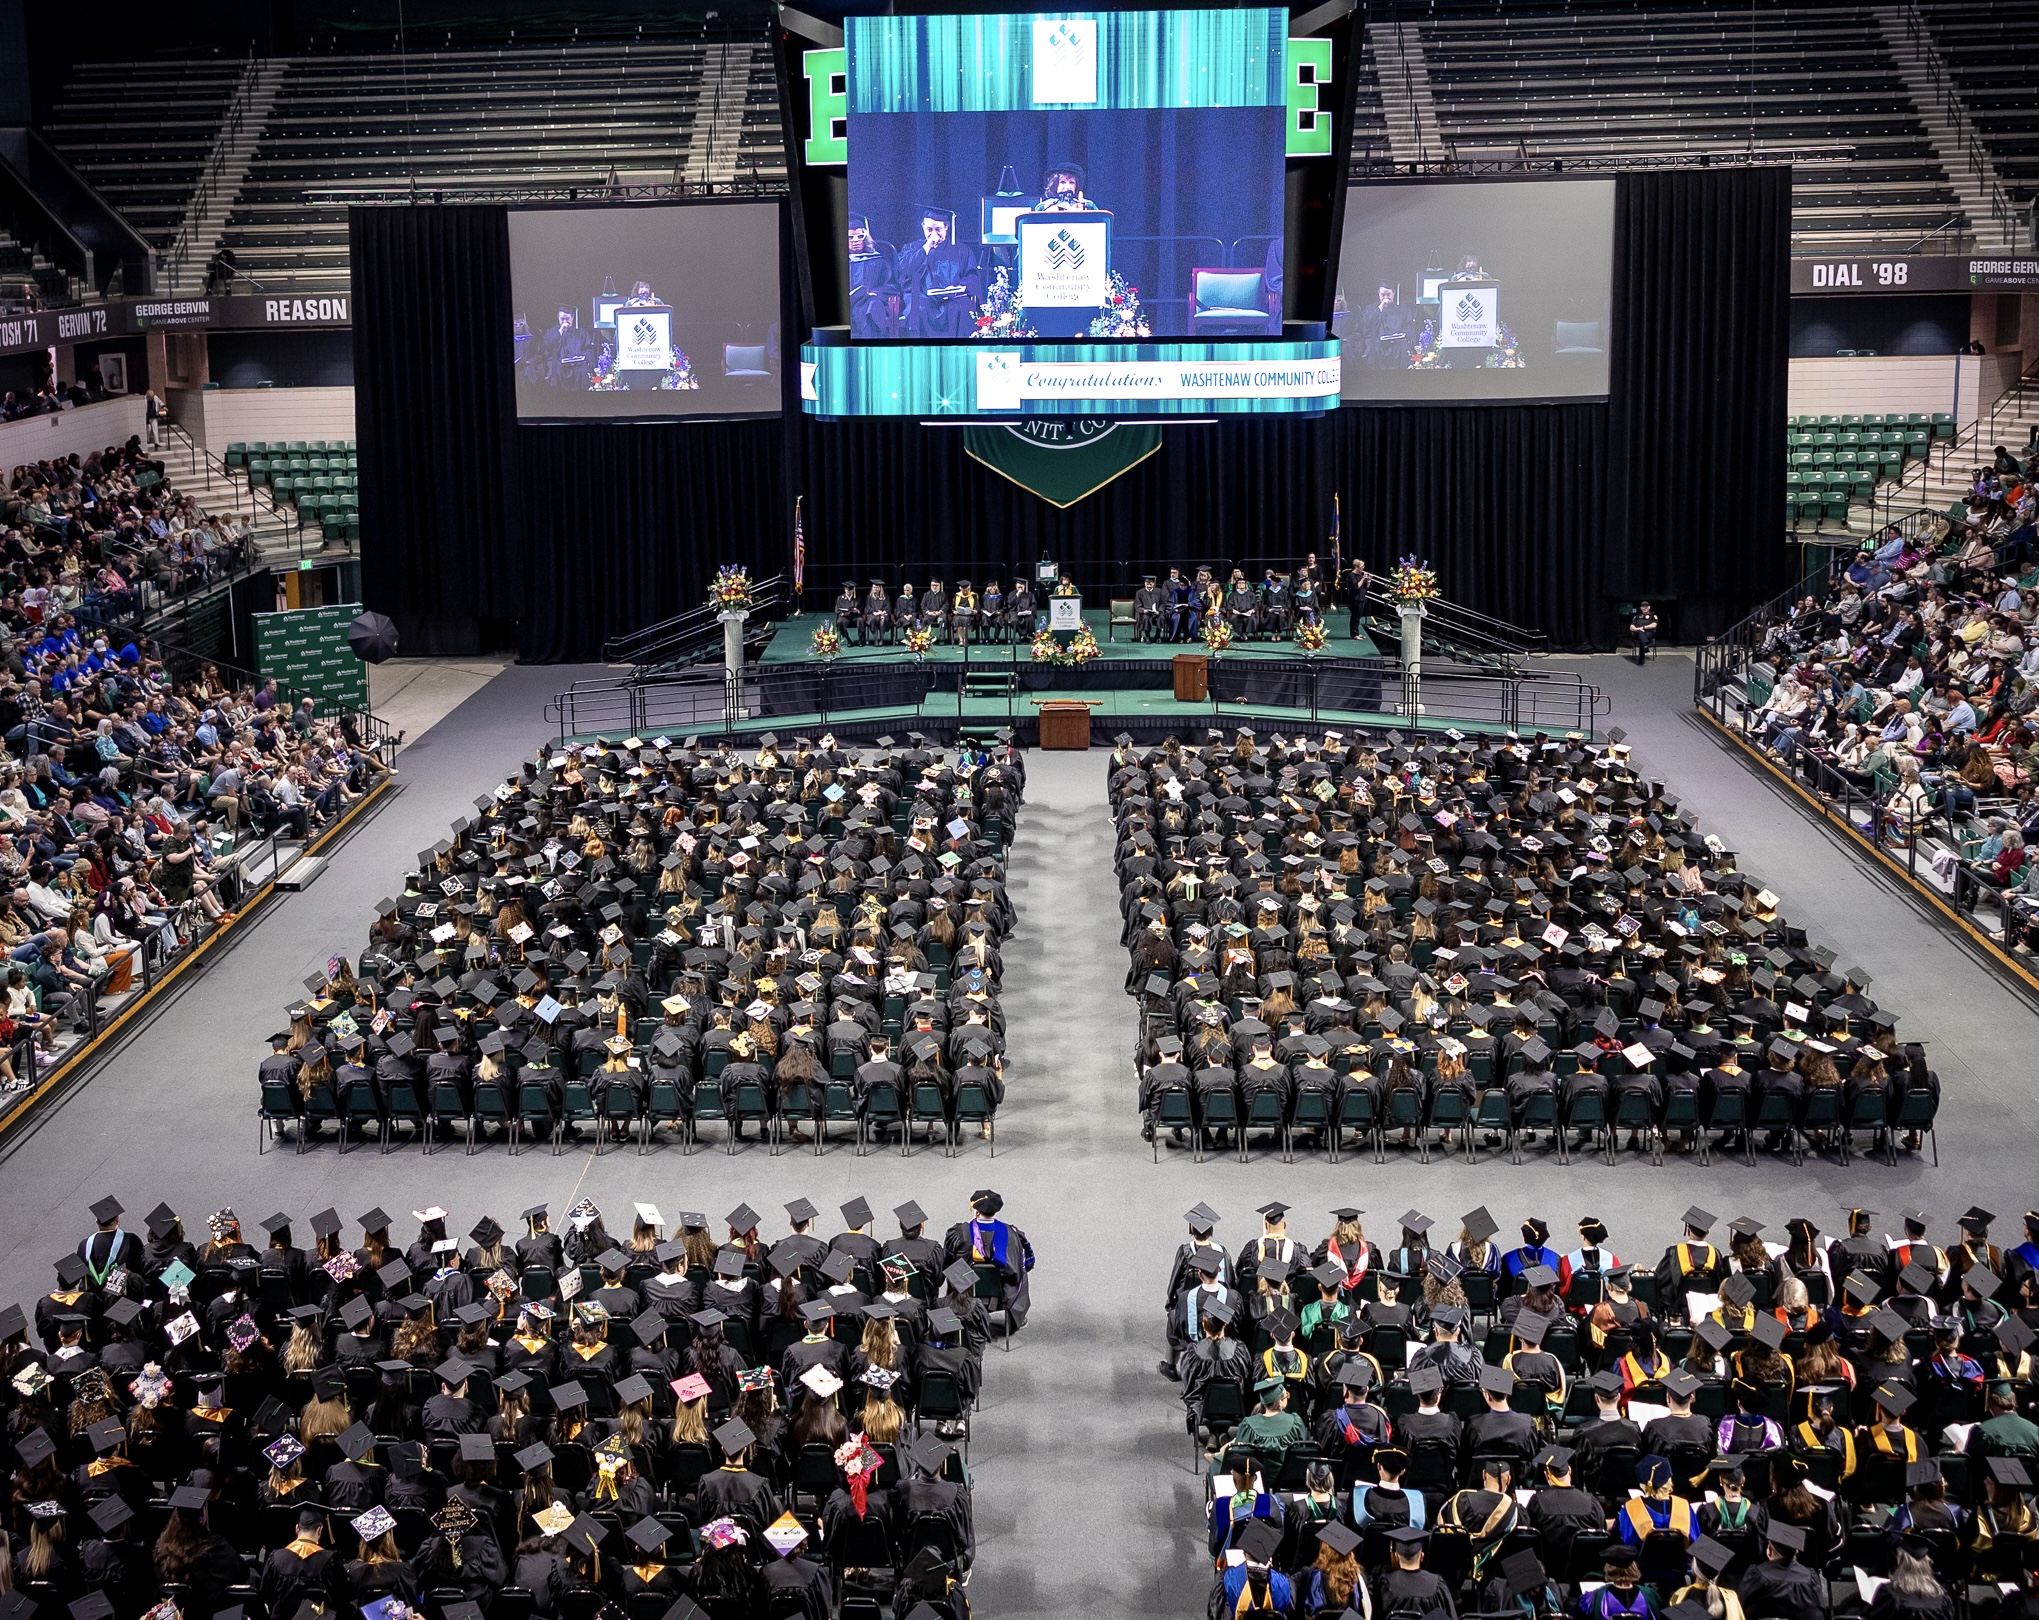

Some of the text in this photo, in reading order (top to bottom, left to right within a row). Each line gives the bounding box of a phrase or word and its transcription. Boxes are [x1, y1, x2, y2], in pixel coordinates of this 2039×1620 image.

[1812, 262, 1908, 287] DIAL '98
[1969, 261, 2012, 273] GEORGE
[135, 301, 210, 317] GEORGE GERVIN
[265, 299, 348, 322] REASON
[24, 319, 39, 343] '71
[58, 310, 107, 338] GERVIN '72
[1027, 372, 1162, 390] Congratulations
[1180, 372, 1252, 387] WASHTENAW
[1254, 370, 1316, 386] COMMUNITY
[275, 1454, 289, 1462] 25
[442, 1505, 465, 1513] RADIATING
[701, 1517, 735, 1537] BLESSED
